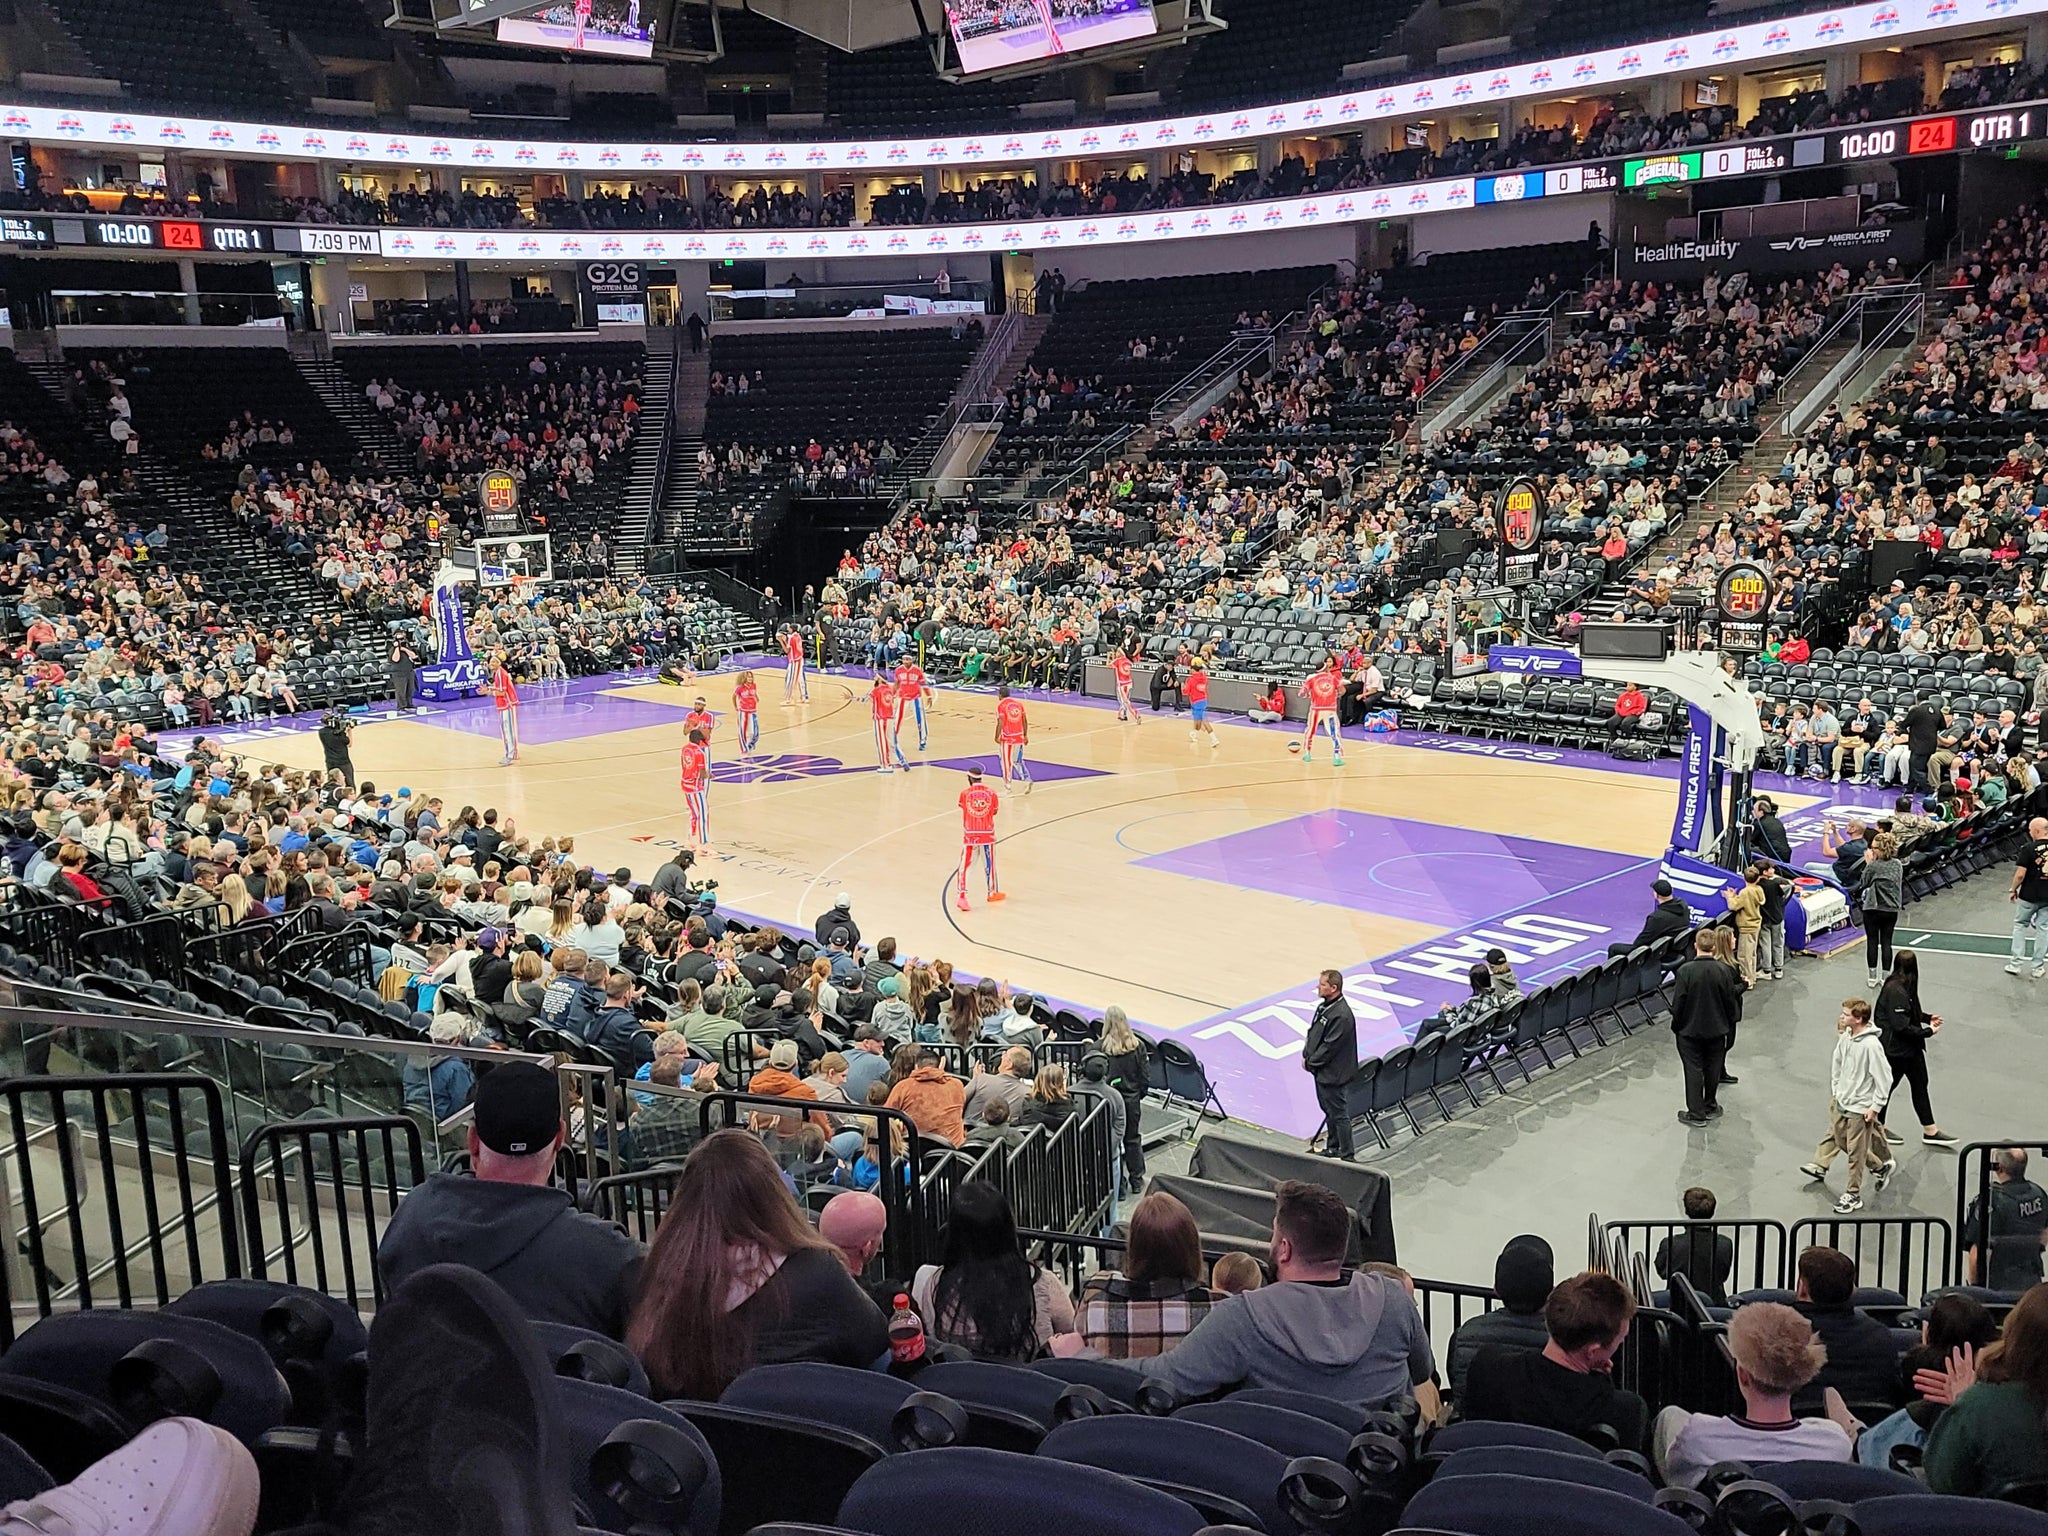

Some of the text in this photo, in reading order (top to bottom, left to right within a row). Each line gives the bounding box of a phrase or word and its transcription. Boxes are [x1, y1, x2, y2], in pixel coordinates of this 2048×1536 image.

[1918, 124, 1945, 148] 24
[1970, 112, 2030, 146] QTR 1
[1766, 146, 1773, 156] 7
[1839, 130, 1896, 159] 10:00
[1719, 153, 1729, 172] 0
[1746, 156, 1784, 171] FOULS: 0
[1559, 173, 1568, 190] 0
[1583, 176, 1616, 189] FOULS: 0
[1635, 163, 1689, 186] GENERALS
[98, 223, 152, 245] 10:00
[170, 228, 194, 246] 24
[213, 228, 262, 251] QTR 1
[308, 233, 372, 252] 7:09 PM
[1827, 229, 1892, 243] AMERICA FIRST
[1634, 237, 1738, 263] HealthEquity
[586, 262, 639, 284] G2G
[592, 284, 622, 292] PROTEIN
[488, 478, 511, 489] 10:00
[488, 490, 512, 508] 24
[1508, 492, 1534, 511] 10:00
[1515, 554, 1539, 565] TISSOT
[1731, 578, 1763, 594] 10:00
[1731, 594, 1758, 612] 24
[450, 600, 464, 656] AMERICA FIRST
[1733, 622, 1764, 631] TISSOT
[443, 681, 468, 690] AMERICA
[1680, 732, 1703, 840] AMERICA FIRST
[739, 860, 842, 888] CENTER
[1385, 914, 1612, 985] UTAH
[2020, 1197, 2043, 1218] POLICE
